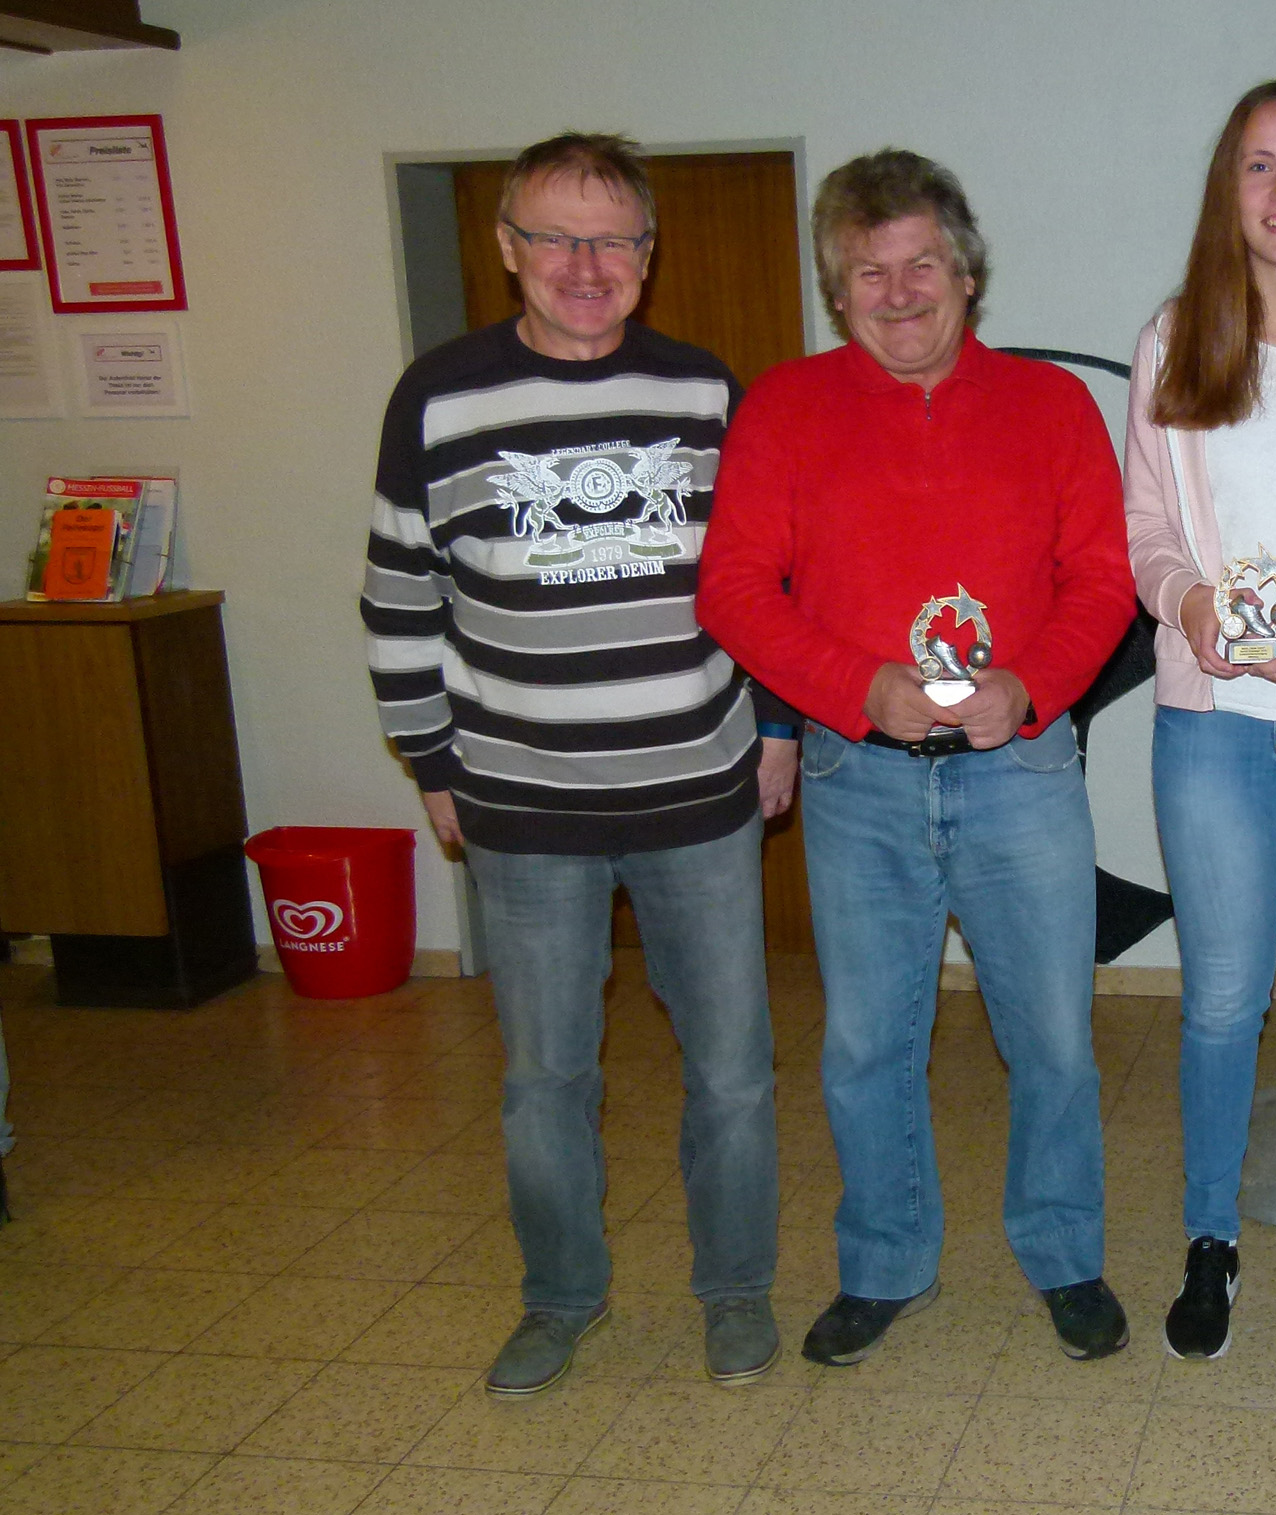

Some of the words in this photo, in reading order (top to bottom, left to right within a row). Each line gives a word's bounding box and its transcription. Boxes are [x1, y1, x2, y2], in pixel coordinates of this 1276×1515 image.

[90, 146, 132, 156] Preisliste
[592, 545, 622, 562] 1979
[540, 567, 617, 585] EXPLORER
[622, 562, 665, 578] DENIM
[280, 940, 345, 953] LANGNESE
